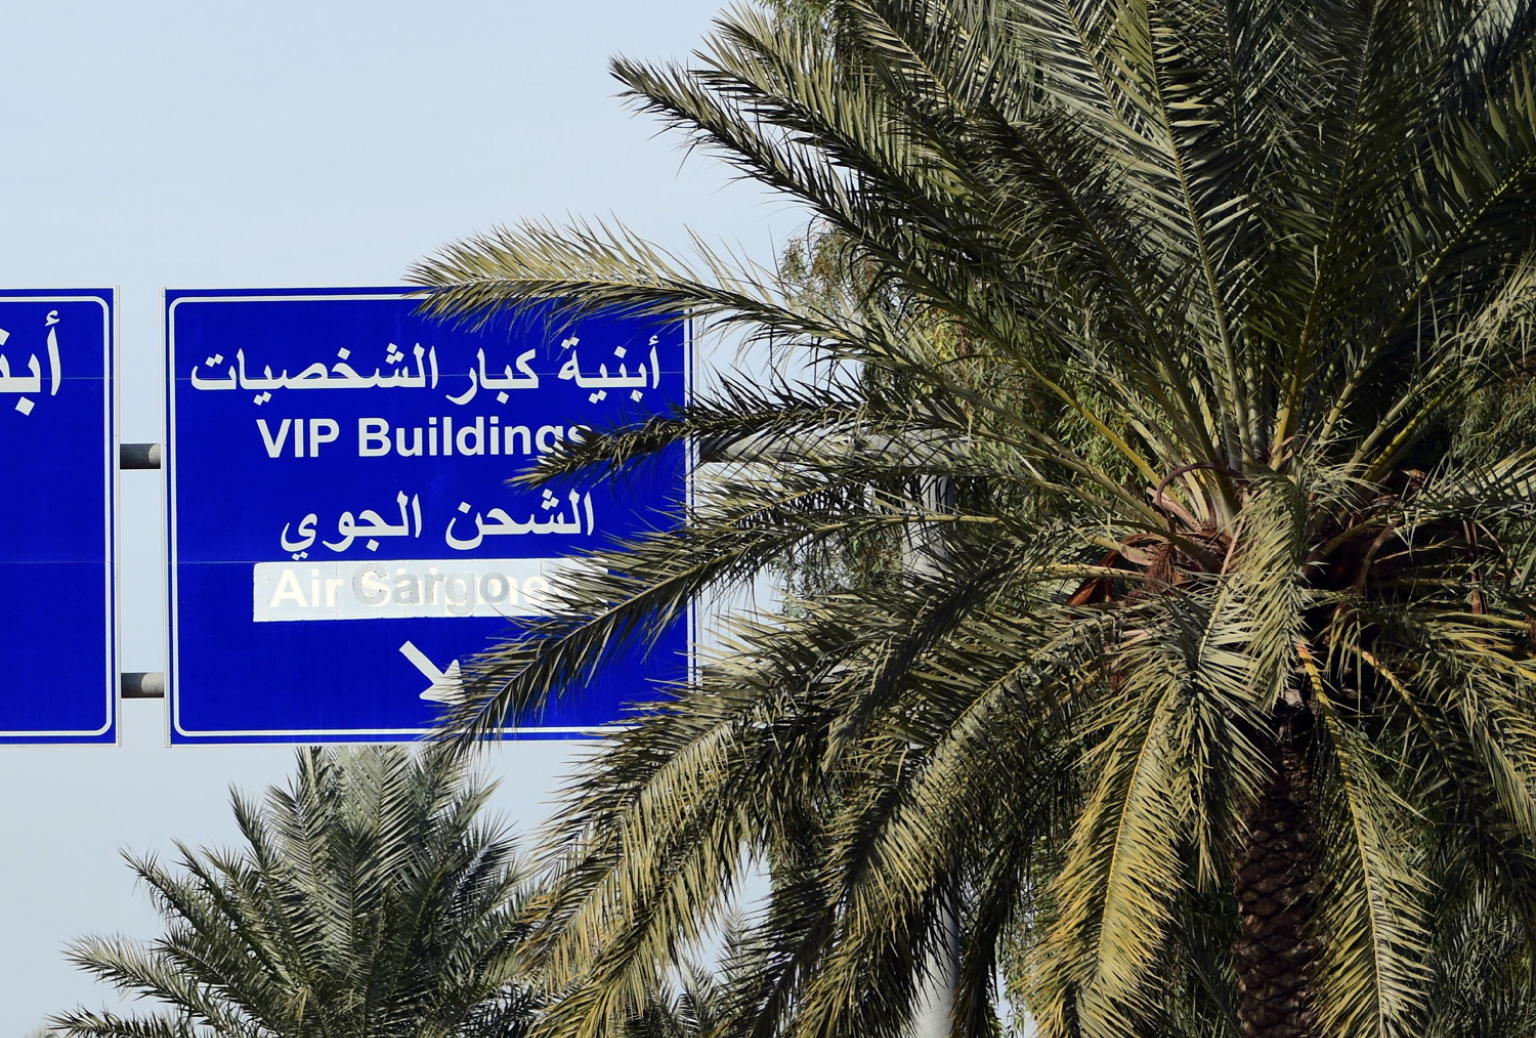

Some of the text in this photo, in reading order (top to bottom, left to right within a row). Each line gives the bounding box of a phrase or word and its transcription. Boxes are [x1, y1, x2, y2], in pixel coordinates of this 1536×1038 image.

[190, 335, 660, 406] أبنية كبار الشخصيات
[256, 418, 340, 458] VIP
[280, 488, 595, 560] الشحن الجوي
